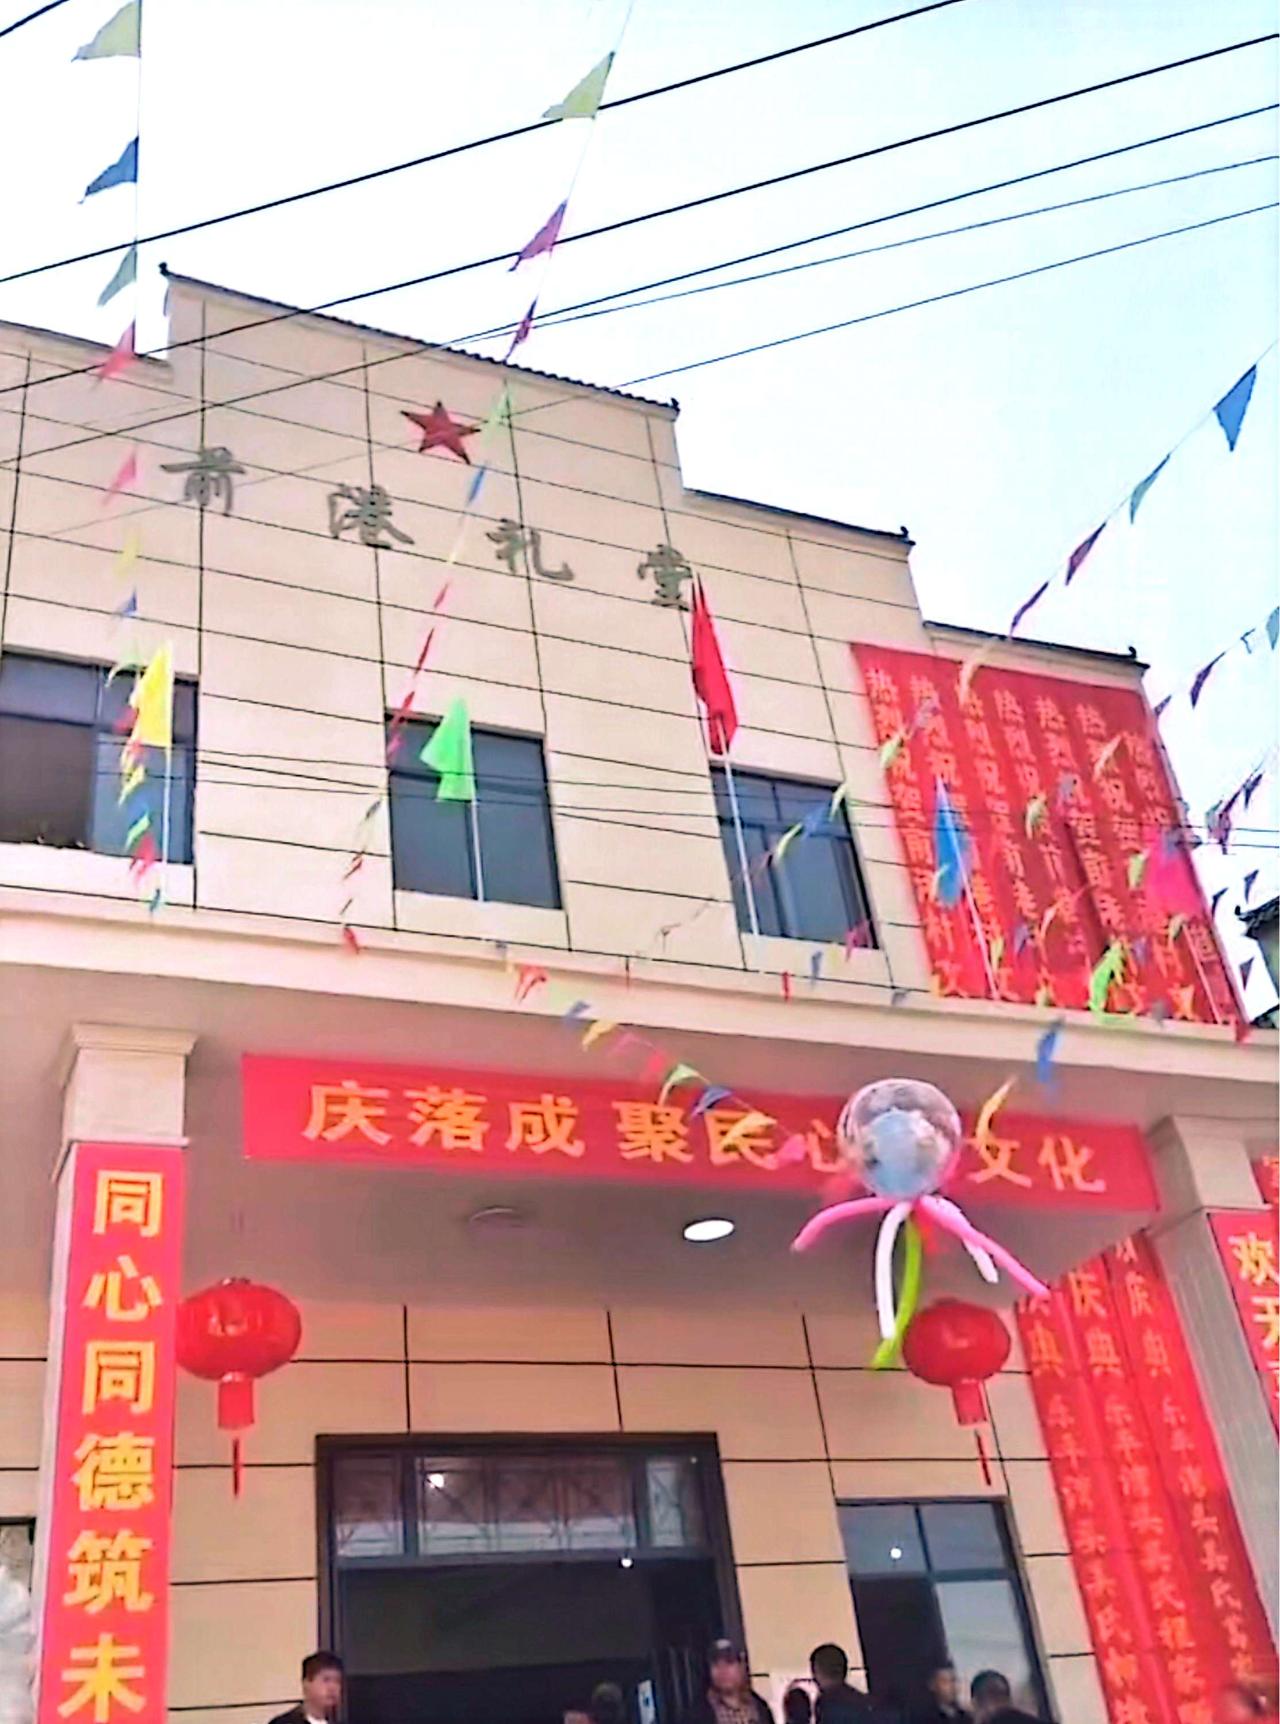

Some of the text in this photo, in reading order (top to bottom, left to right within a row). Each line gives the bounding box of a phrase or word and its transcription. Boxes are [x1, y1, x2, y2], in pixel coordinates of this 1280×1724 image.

[302, 1078, 586, 1158] 庆落成
[58, 1170, 162, 1722] 同心同德筑未
